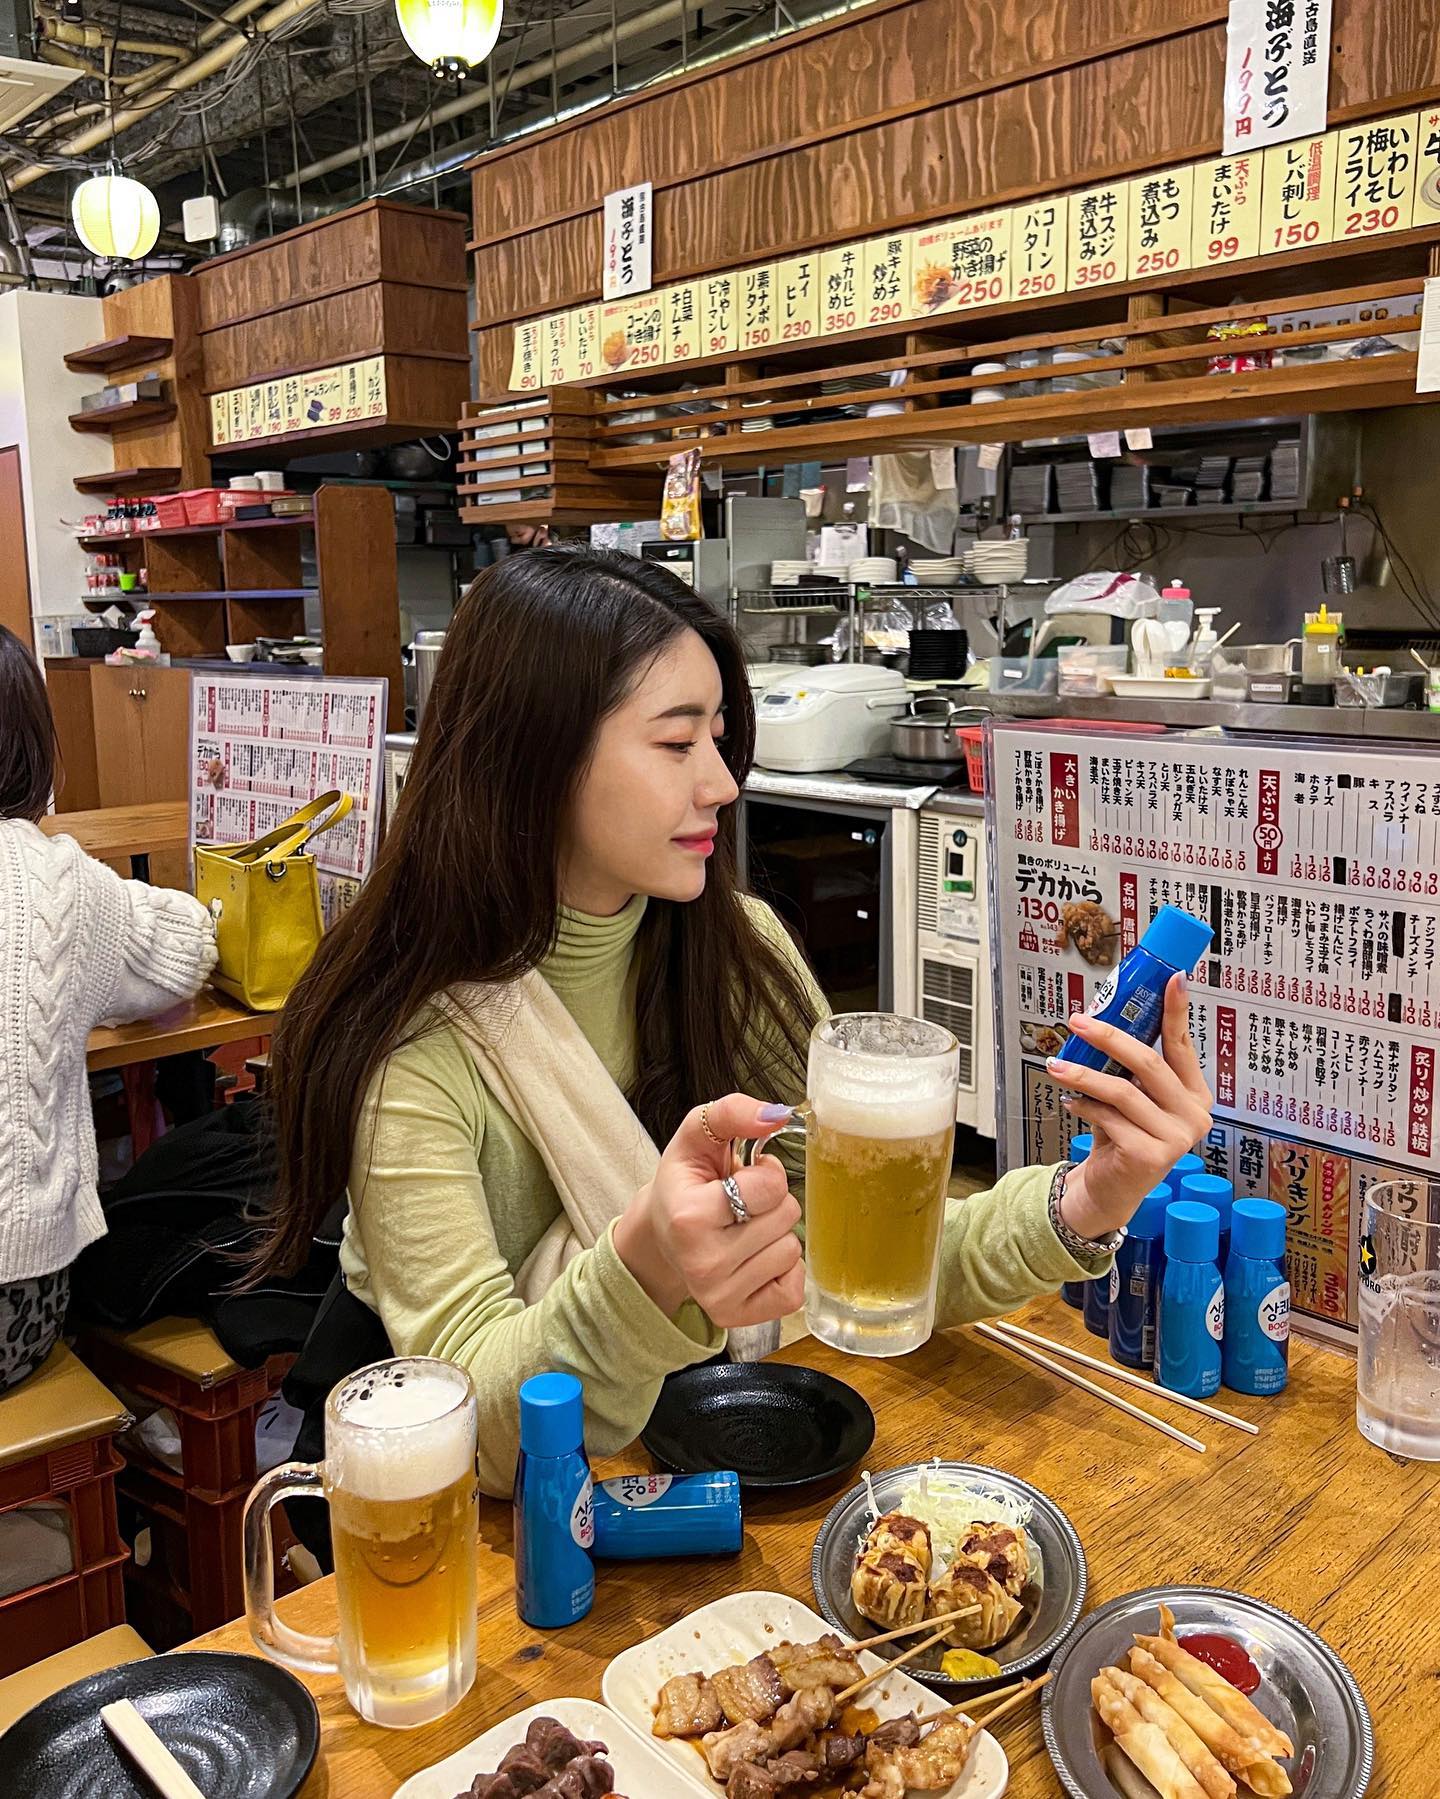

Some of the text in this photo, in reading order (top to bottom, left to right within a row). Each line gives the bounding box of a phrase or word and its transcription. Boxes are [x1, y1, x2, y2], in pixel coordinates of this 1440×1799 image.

[1263, 0, 1294, 128] 海ぶどう
[1234, 158, 1250, 206] 天ぷら
[1281, 149, 1306, 220] レバ刺し
[1345, 135, 1364, 207] フライ
[1364, 128, 1388, 204] 梅しそ
[1387, 127, 1410, 199] いわし
[1141, 181, 1161, 249] 煮込み
[1162, 178, 1180, 220] もつ
[1210, 164, 1233, 235] まいたけ
[1344, 205, 1399, 235] 230
[1024, 210, 1039, 273] バター
[1042, 207, 1056, 270] コーン
[1080, 196, 1098, 261] 煮込み
[1099, 191, 1118, 257] 牛スジ
[1274, 220, 1319, 248] 150
[888, 239, 902, 299] 豚キムチ
[952, 236, 994, 262] 野菜の
[952, 250, 1008, 280] かき揚げ
[1136, 248, 1179, 274] 250
[1207, 236, 1239, 261] 99
[798, 263, 810, 298] エイ
[828, 274, 842, 311] 炒め
[842, 251, 856, 308] 牛カルビ
[873, 264, 887, 301] 炒め
[958, 277, 1003, 305] 250
[1017, 273, 1056, 297] 250
[1075, 260, 1117, 286] 350
[627, 308, 661, 329] コーンの
[672, 292, 682, 342] キムチ
[708, 283, 718, 334] ピーマン
[720, 280, 731, 331] 冷やし
[746, 275, 758, 328] リタン
[758, 271, 769, 325] 素ナポ
[786, 285, 797, 319] ヒレ
[826, 310, 856, 333] 350
[868, 302, 902, 324] 290
[579, 313, 592, 377] しいたけ 70
[674, 343, 690, 359] 90
[711, 335, 727, 352] 90
[746, 327, 770, 347] 150
[783, 319, 811, 340] 230
[551, 368, 564, 382] 70
[631, 344, 660, 366] 250
[520, 375, 536, 388] 90
[329, 407, 342, 421] 99
[346, 407, 362, 421] 230
[368, 402, 383, 416] 150
[1064, 759, 1077, 800] 大きい
[1089, 755, 1099, 785] 海老天
[1112, 758, 1122, 806] 玉子焼き天
[1125, 759, 1134, 807] ピーマン天
[1136, 760, 1146, 790] キス天
[1160, 763, 1170, 792] とり天
[1172, 763, 1183, 822] 紅ショウガ天
[1185, 764, 1197, 804] 玉ねぎ天
[1211, 766, 1222, 797] なす天
[1223, 767, 1235, 818] かぼちゃ天
[1237, 768, 1249, 819] れんこん天
[1309, 774, 1321, 806] ホタテ
[1323, 775, 1335, 807] チーズ
[1352, 776, 1365, 789] 豚
[1053, 786, 1066, 841] かき揚げ
[1101, 758, 1111, 853] まいたけ天 99
[1148, 761, 1158, 859] アスパラ天 90
[1198, 765, 1209, 866] しいたけ天 70
[1368, 778, 1380, 811] キス
[1398, 780, 1411, 835] ウインナー
[1414, 782, 1427, 815] つくね
[1258, 775, 1279, 873] 天ぷら 50円 より
[1294, 772, 1306, 879] 海老 120
[1381, 779, 1396, 890] アスパラ 90
[1015, 865, 1103, 905] デカから
[1122, 882, 1135, 911] 名物
[1223, 889, 1234, 956] 小海老からあげ
[1290, 898, 1302, 939] 海老カツ
[1332, 904, 1346, 966] 揚げにんにく
[1347, 906, 1360, 969] ポテトフライ
[1376, 910, 1390, 975] サバの味噌煮
[1264, 894, 1274, 997] バッファローチキン 250
[1318, 902, 1331, 1008] おつまみ玉子焼 190
[1424, 916, 1436, 971] アジフライ
[1199, 961, 1207, 984] 290
[1406, 914, 1421, 1024] チーズメンチ 190
[1198, 1004, 1207, 1070] チキンラーメン
[1220, 1013, 1235, 1102] ごはん・甘味
[1248, 1012, 1259, 1071] 牛カルビ炒め
[1261, 1016, 1272, 1075] ホルモン炒め
[1288, 1021, 1299, 1071] もやし炒め
[1301, 1023, 1313, 1054] 塩サバ
[1315, 1026, 1327, 1088] 羽根つき餃子
[1344, 1033, 1355, 1073] エイヒレ
[1274, 1017, 1286, 1119] 豚キムチ炒め 290
[1329, 1030, 1341, 1133] コーンバター 250
[1358, 1035, 1370, 1097] 赤ウインナー
[1372, 1039, 1385, 1090] ハムエッグ
[1044, 1084, 1054, 1111] ラムネ
[1386, 1040, 1400, 1147] 素ナポリタン 150
[1239, 1135, 1265, 1179] 焼酎
[1262, 1298, 1290, 1322] 상쾌
